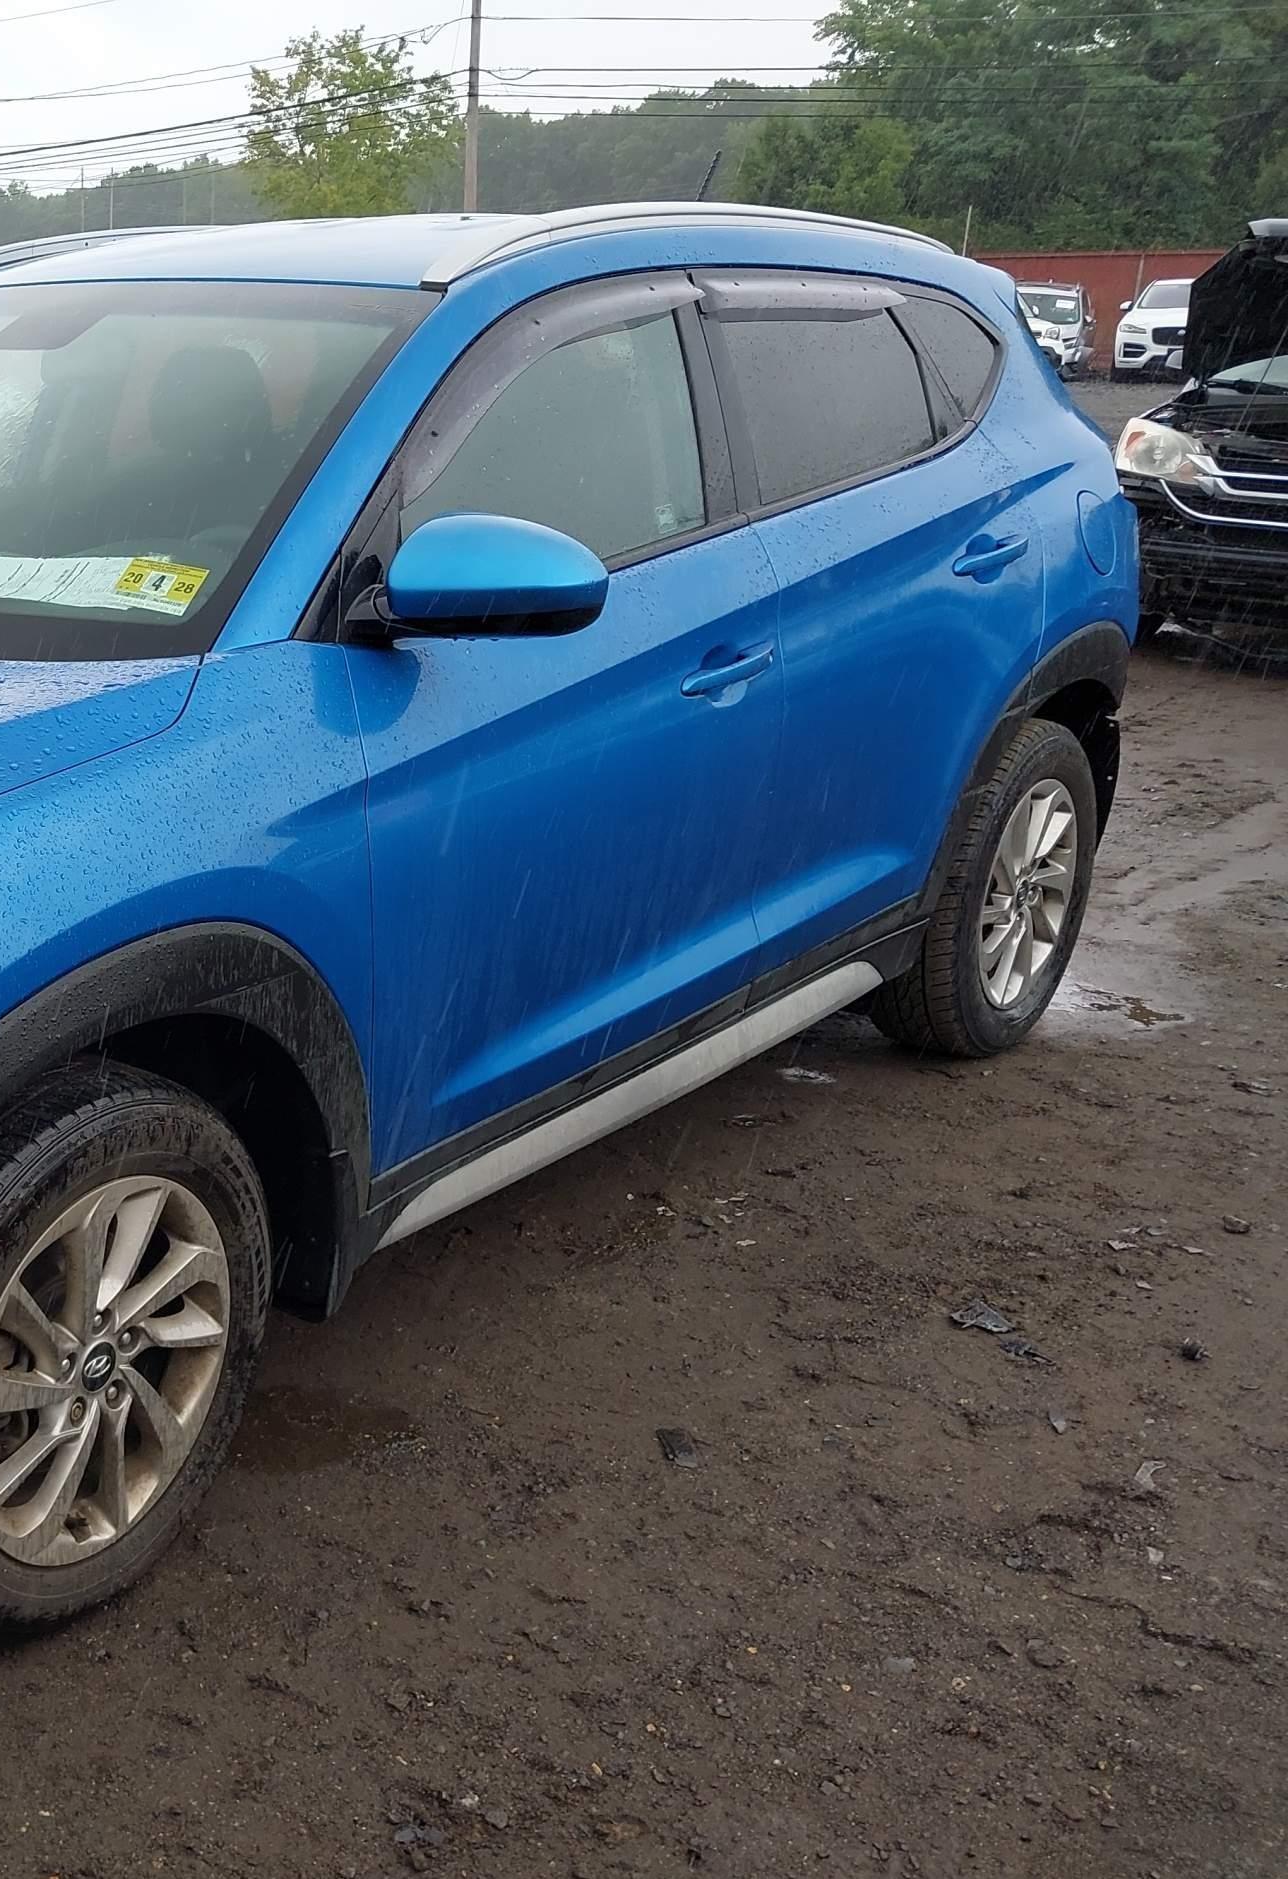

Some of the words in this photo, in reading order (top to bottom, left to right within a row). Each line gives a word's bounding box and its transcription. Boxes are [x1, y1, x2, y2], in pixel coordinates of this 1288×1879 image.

[123, 571, 144, 584] 20
[152, 575, 167, 591] 4
[174, 581, 195, 594] 28
